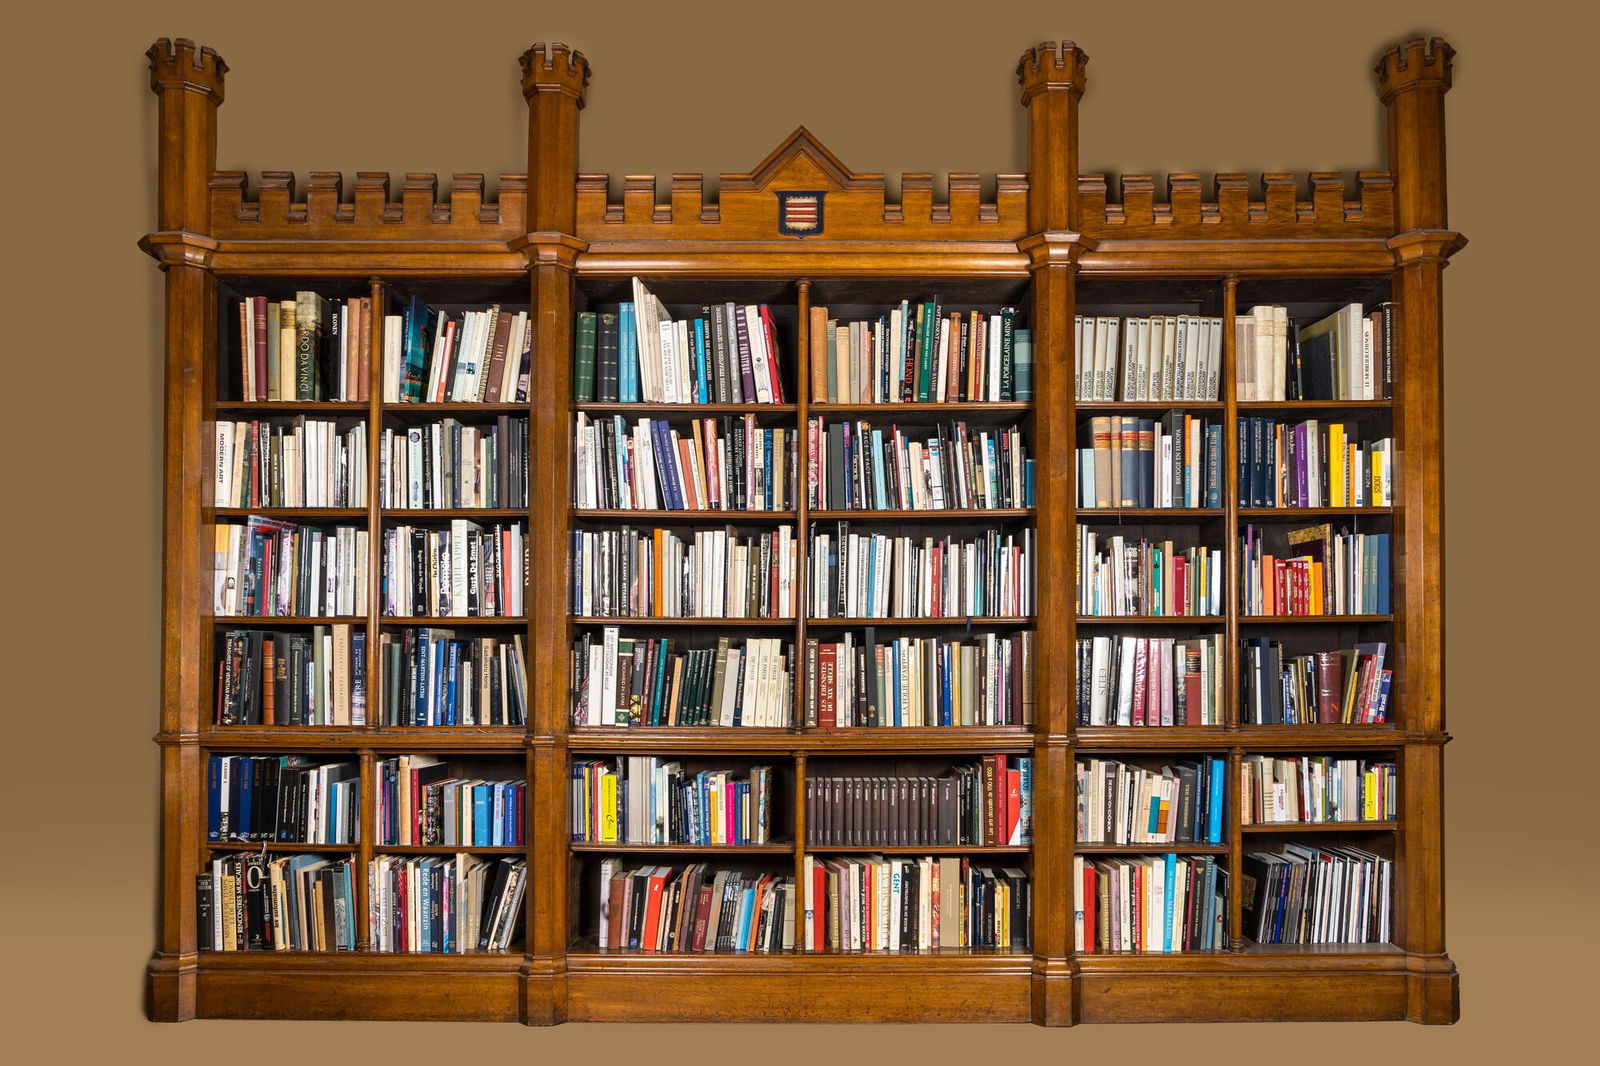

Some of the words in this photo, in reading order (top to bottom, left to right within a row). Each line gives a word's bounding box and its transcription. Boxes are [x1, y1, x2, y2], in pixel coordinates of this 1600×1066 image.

[905, 358, 913, 383] HOND
[300, 367, 309, 392] VINCI
[1003, 380, 1009, 388] LA
[1175, 452, 1181, 460] EN
[469, 563, 476, 573] De
[1098, 668, 1107, 696] CELTS
[826, 701, 833, 711] DU
[1378, 694, 1387, 712] Brazil
[902, 706, 908, 715] LA
[235, 862, 243, 894] MUSICALES
[422, 888, 429, 896] en
[422, 898, 430, 930] Waanzin
